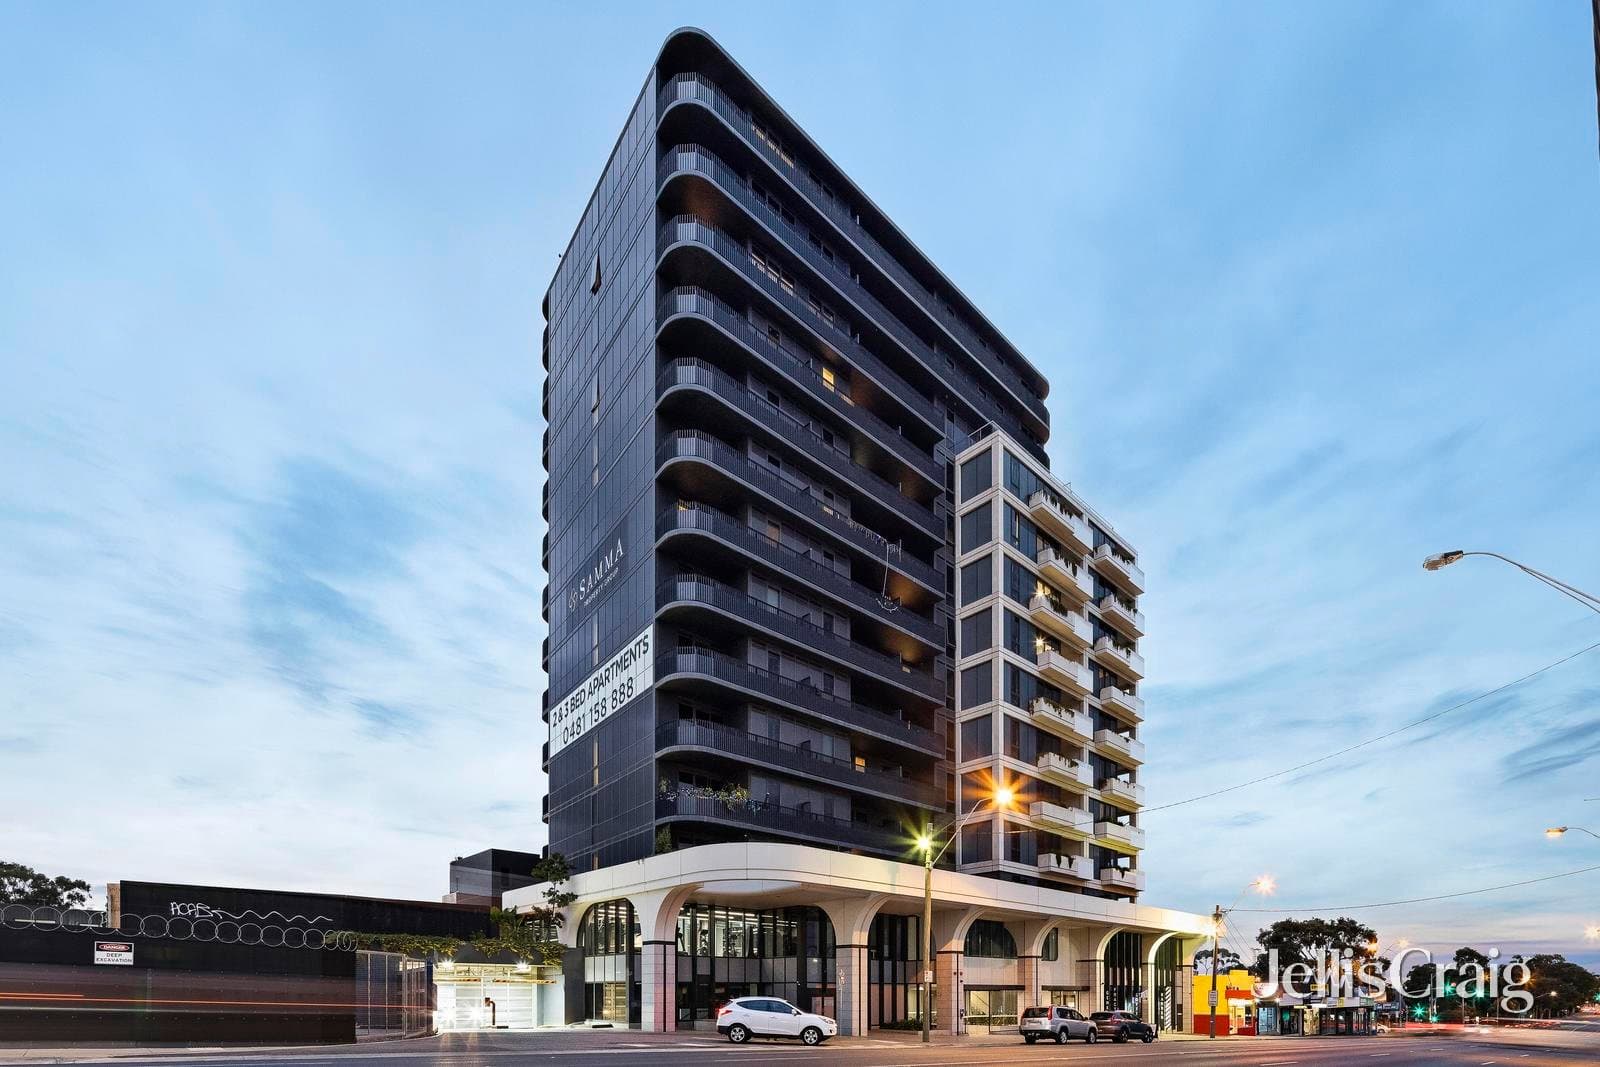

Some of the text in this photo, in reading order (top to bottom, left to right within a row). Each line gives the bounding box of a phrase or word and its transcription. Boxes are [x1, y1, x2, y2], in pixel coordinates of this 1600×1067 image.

[579, 537, 624, 600] SAMMA
[552, 634, 649, 728] 2 & 3 BED APARTMENTS
[562, 676, 634, 745] 0481 158 888
